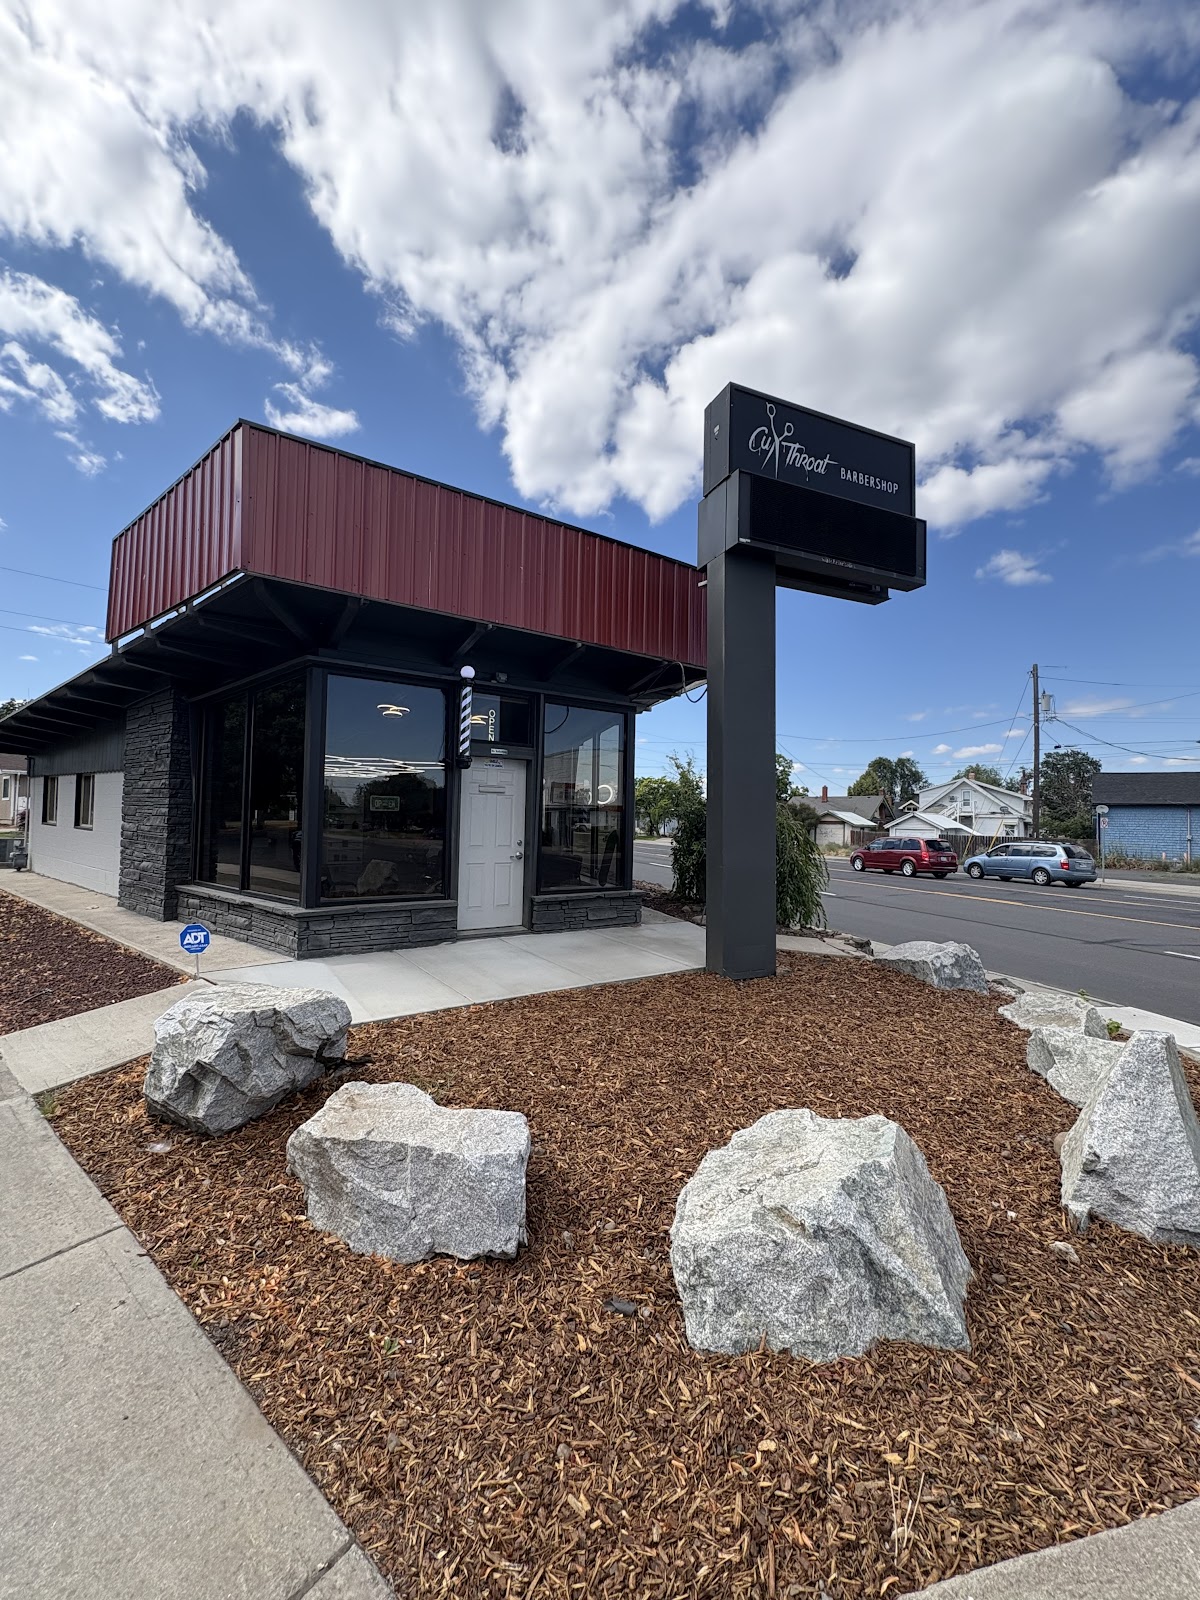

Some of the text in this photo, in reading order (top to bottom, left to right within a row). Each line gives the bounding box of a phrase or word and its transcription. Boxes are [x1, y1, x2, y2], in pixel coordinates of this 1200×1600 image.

[781, 442, 839, 481] Throat
[840, 467, 899, 494] BARBERSHOP
[488, 709, 496, 741] OPEN
[183, 931, 207, 945] ADT
